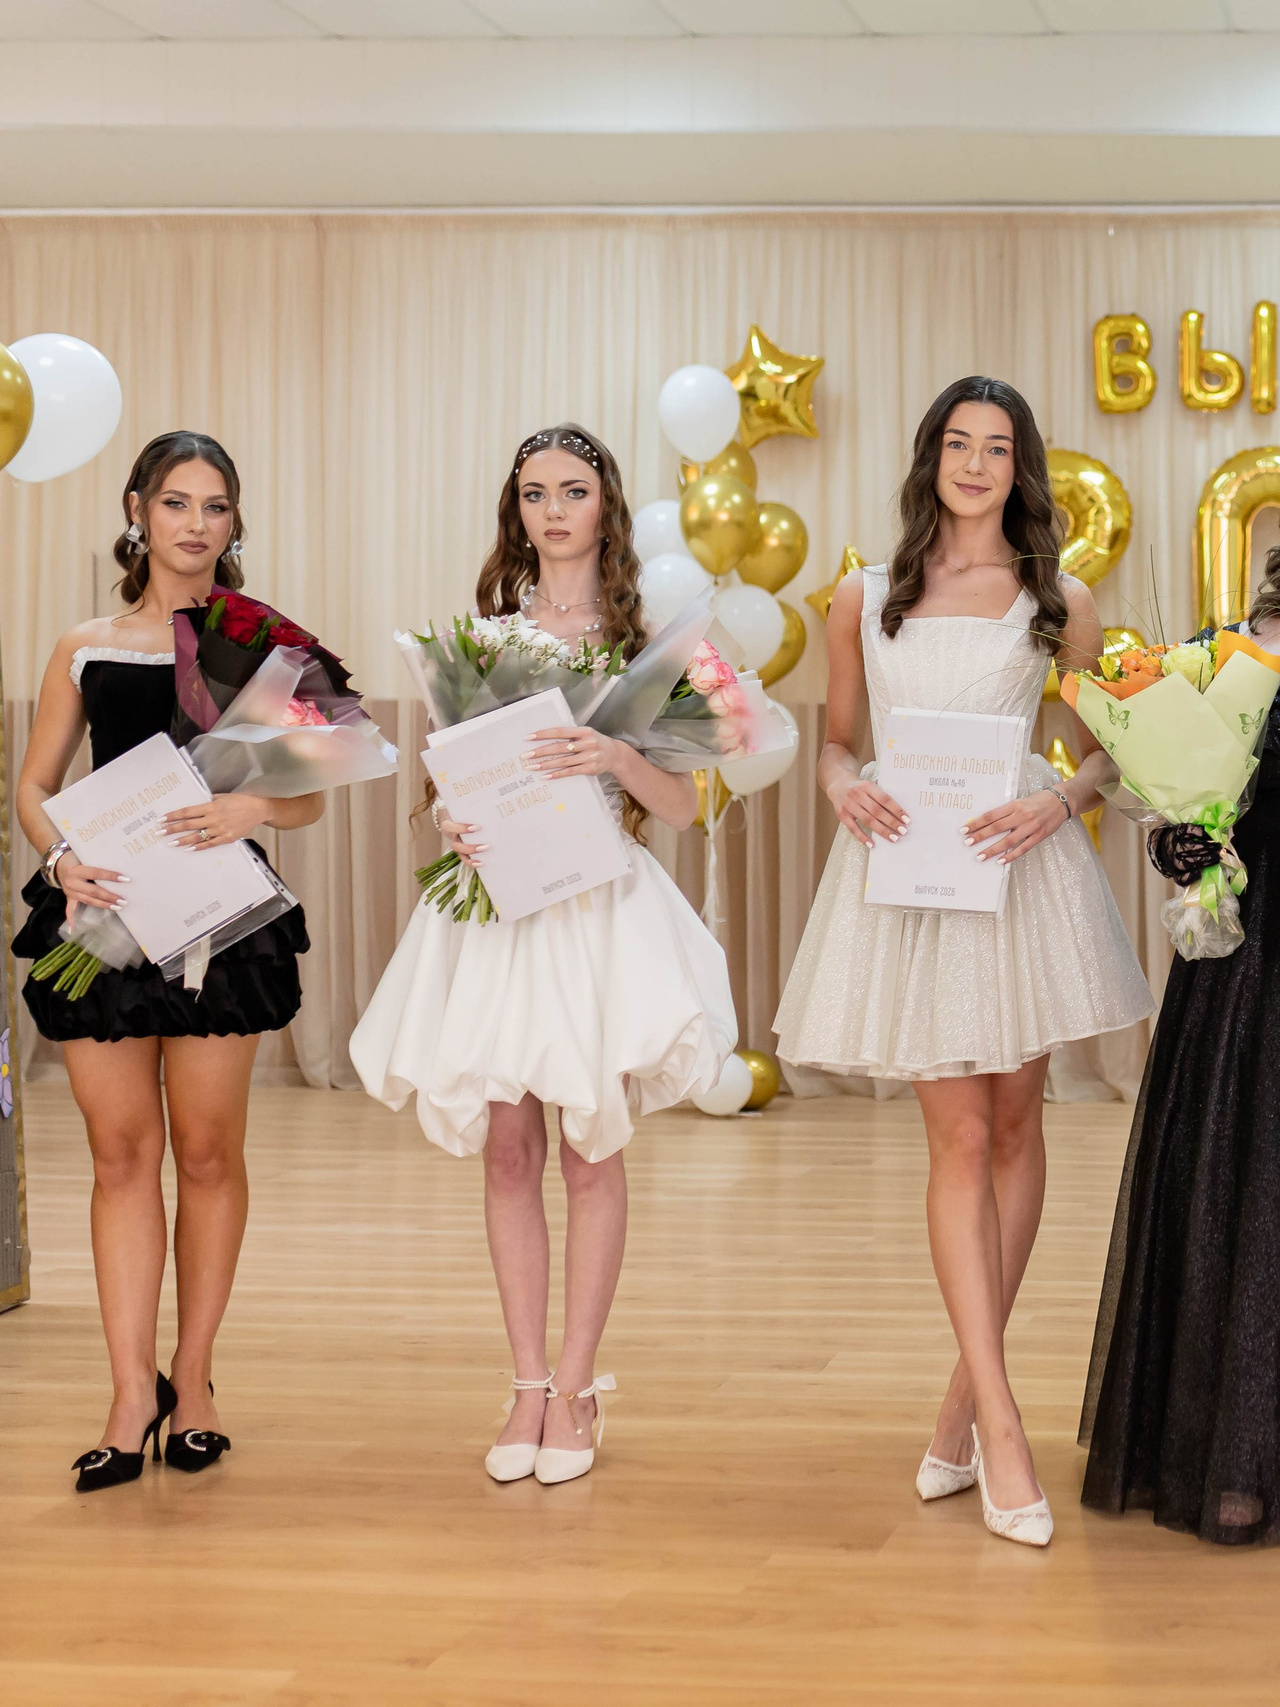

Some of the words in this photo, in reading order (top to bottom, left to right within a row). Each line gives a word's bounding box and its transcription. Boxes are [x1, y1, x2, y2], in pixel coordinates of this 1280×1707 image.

[893, 752, 958, 773] ВЫПУСКНОЙ
[960, 759, 1005, 775] АЛЬБОМ
[452, 759, 519, 798] ВЫПУСКНОЙ
[929, 777, 949, 787] ШКОЛА
[77, 796, 139, 843] ВЫПУСКНОЙ
[141, 771, 181, 807] АЛЬБОМ
[495, 802, 516, 819] 11А
[516, 785, 553, 811] КЛАСС
[919, 791, 934, 808] 11А
[939, 793, 973, 810] КЛАСС
[123, 838, 144, 857] 11А
[914, 885, 939, 896] ВЫПУСК
